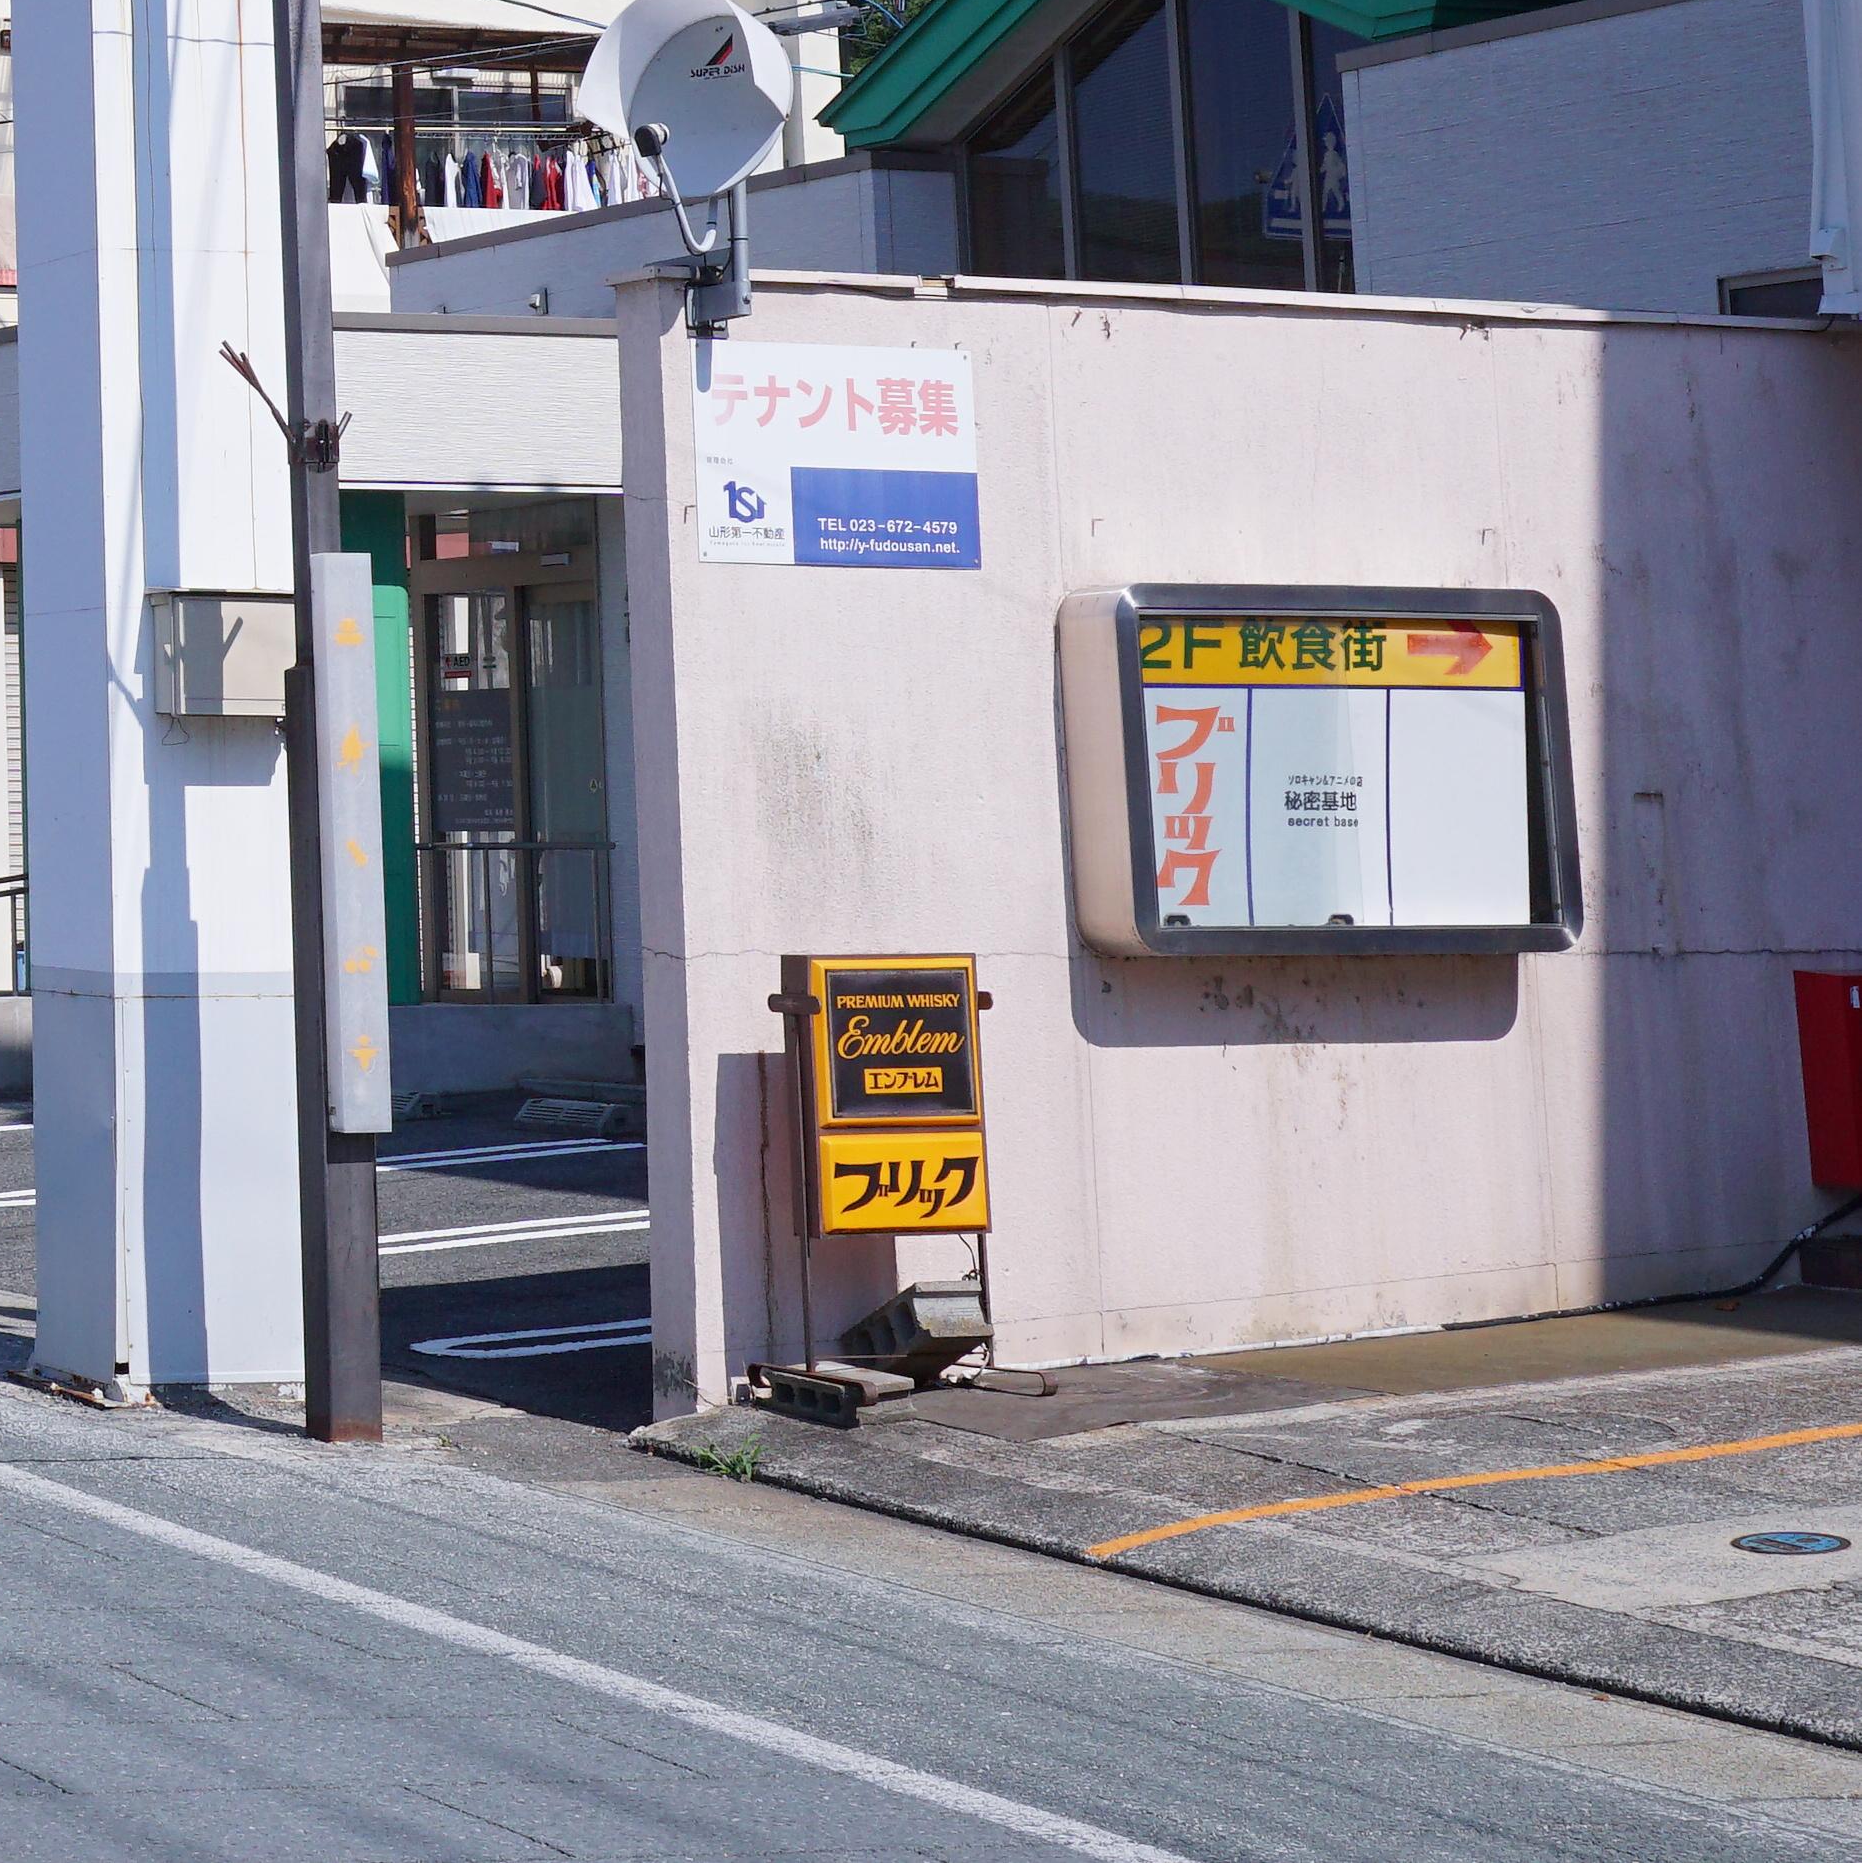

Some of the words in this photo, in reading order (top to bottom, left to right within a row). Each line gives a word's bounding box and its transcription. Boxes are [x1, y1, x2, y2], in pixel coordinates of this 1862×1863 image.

[690, 66, 720, 78] SUPER
[712, 373, 959, 437] テナント募集
[708, 525, 785, 540] 山形第一不動産
[817, 517, 846, 532] TEL
[849, 518, 958, 535] 023-672-4579
[1238, 618, 1387, 672] 飲食街
[453, 655, 470, 667] AED
[1155, 704, 1236, 907] ブリック
[1284, 790, 1358, 812] 秘密基地
[1287, 816, 1330, 828] secret
[1334, 816, 1359, 828] base
[836, 993, 904, 1010] PREMIUM
[906, 993, 961, 1009] WHISKY
[837, 1015, 965, 1060] Emblem
[868, 1072, 940, 1090] エンブレム
[833, 1156, 980, 1220] ブリック
